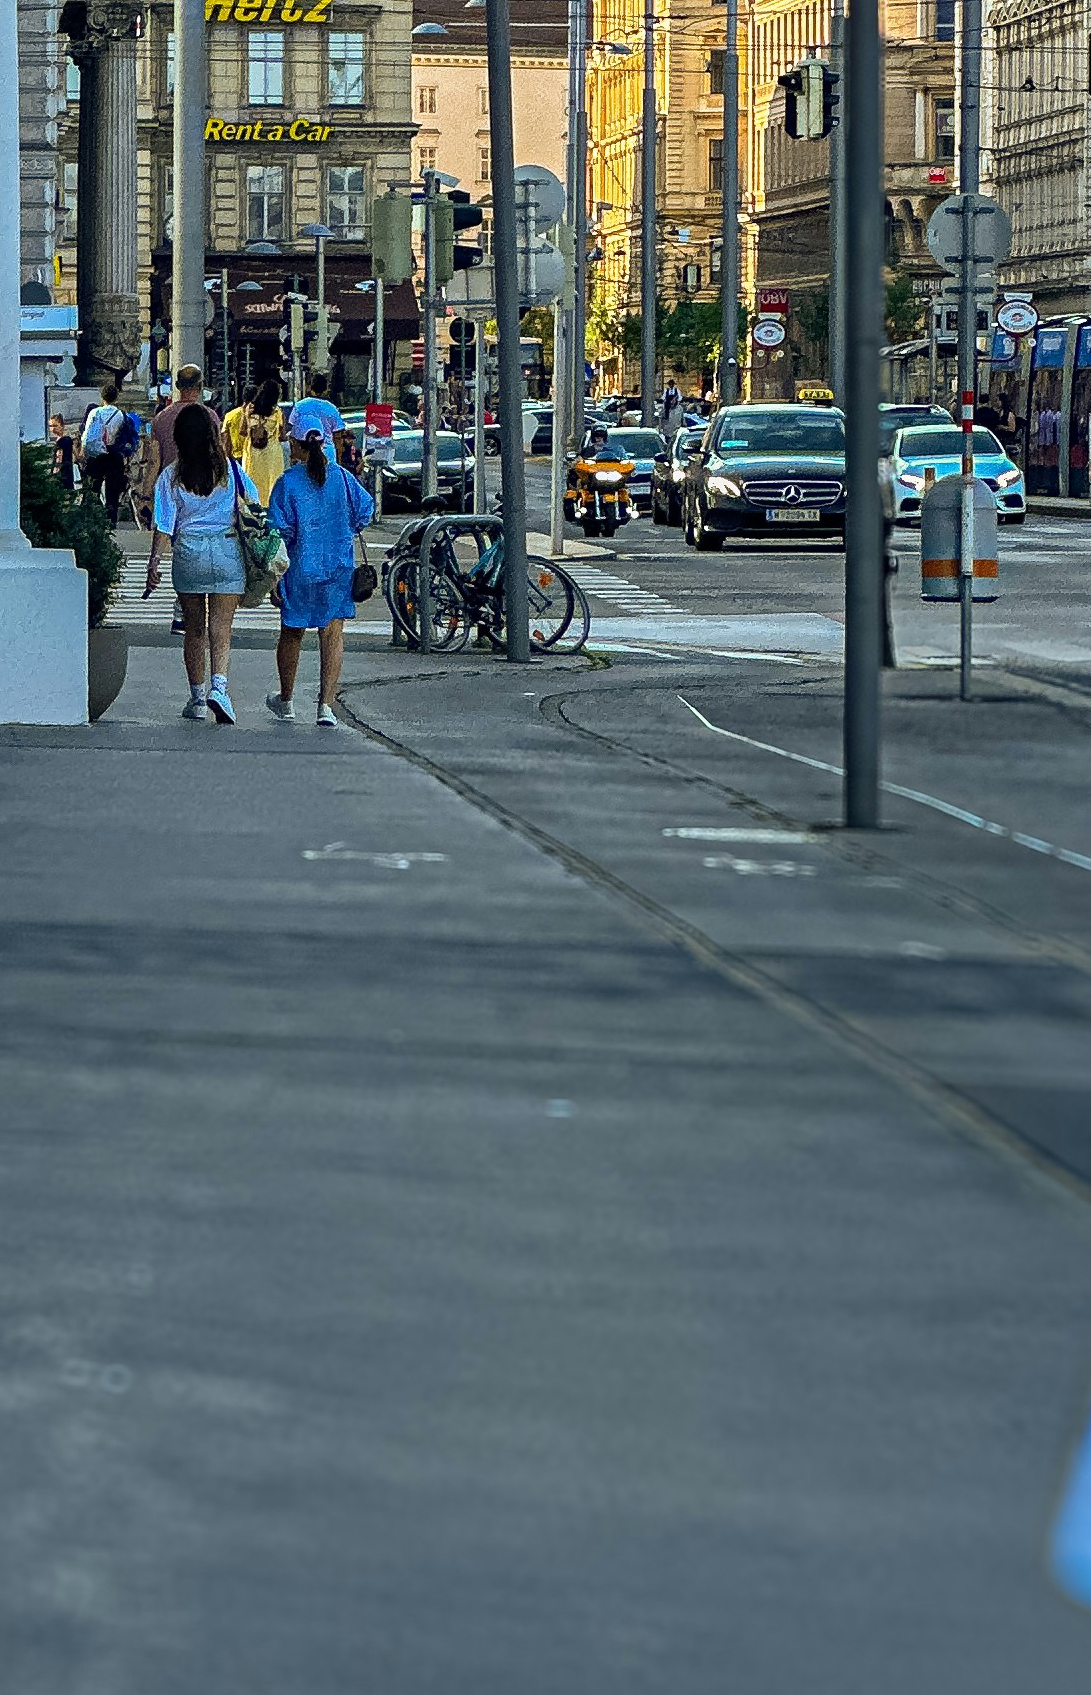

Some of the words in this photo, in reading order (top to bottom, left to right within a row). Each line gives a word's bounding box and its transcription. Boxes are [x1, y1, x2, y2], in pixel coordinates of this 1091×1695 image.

[204, 118, 264, 141] Rent
[267, 125, 284, 141] a
[289, 118, 335, 141] Car
